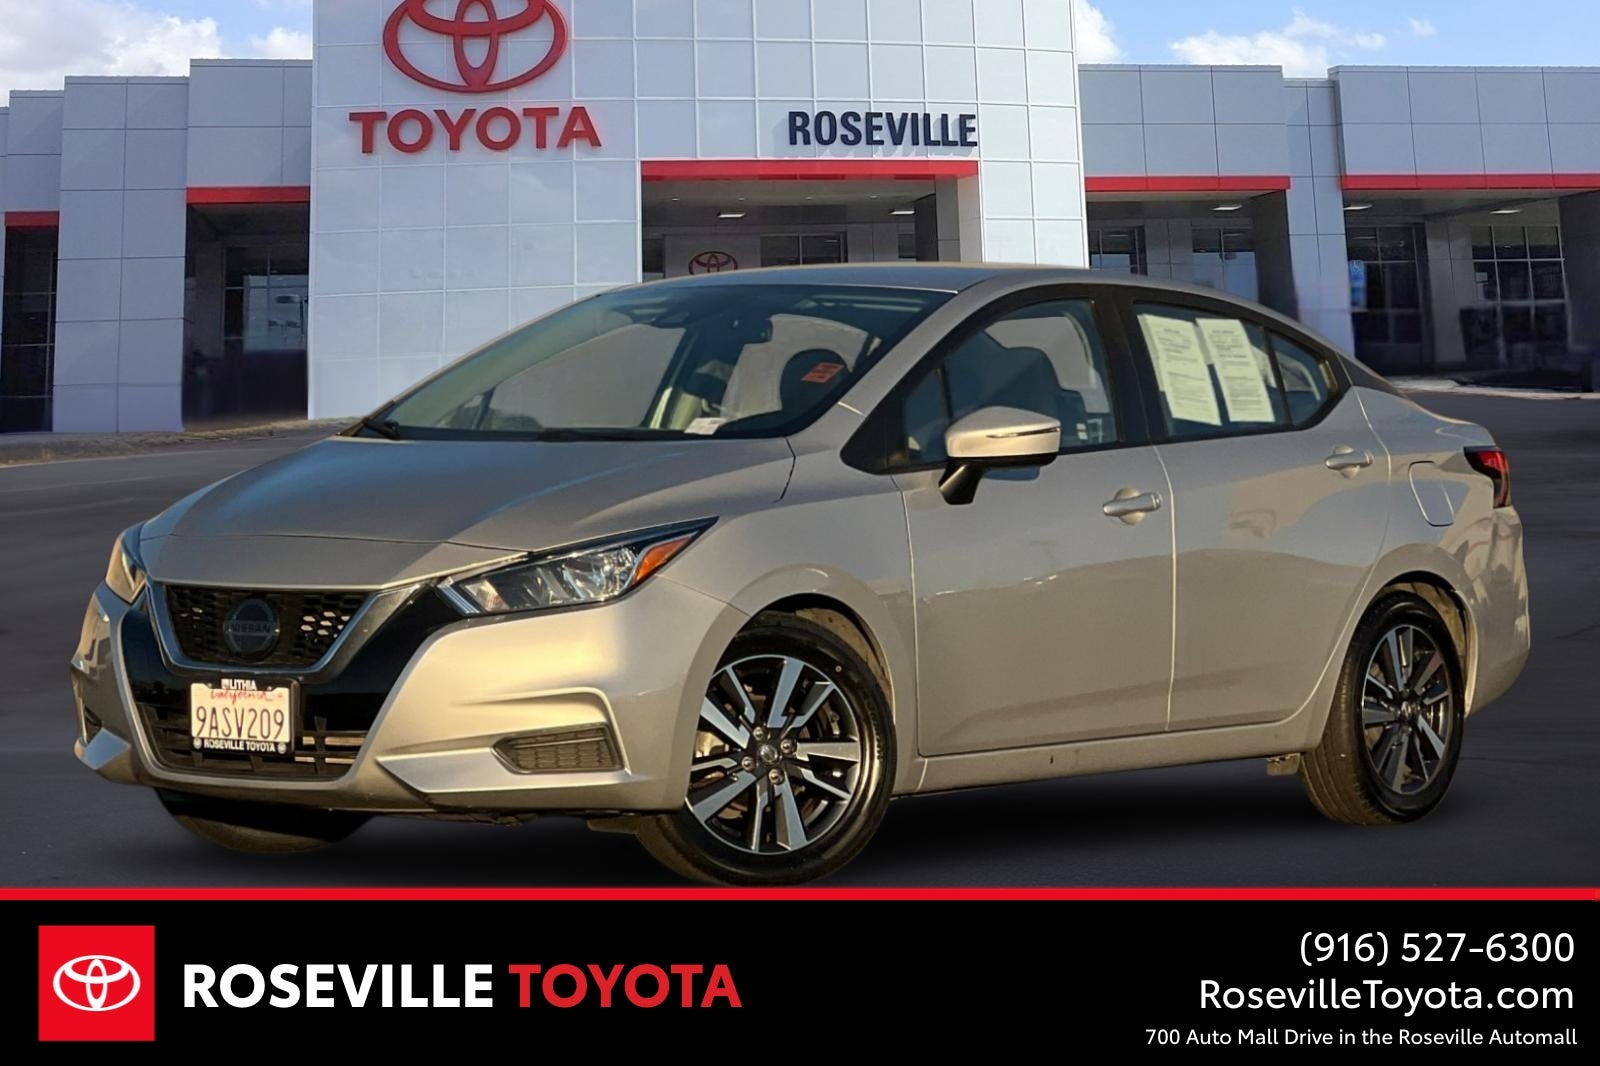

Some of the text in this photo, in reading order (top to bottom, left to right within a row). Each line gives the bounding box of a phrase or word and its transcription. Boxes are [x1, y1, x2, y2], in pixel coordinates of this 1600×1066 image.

[349, 106, 602, 154] TOYOTA
[788, 110, 978, 147] ROSEVILLE
[229, 678, 257, 691] LITHIA
[195, 705, 285, 741] 9ASV209
[203, 739, 276, 753] ROSEVILLE TOYOTA
